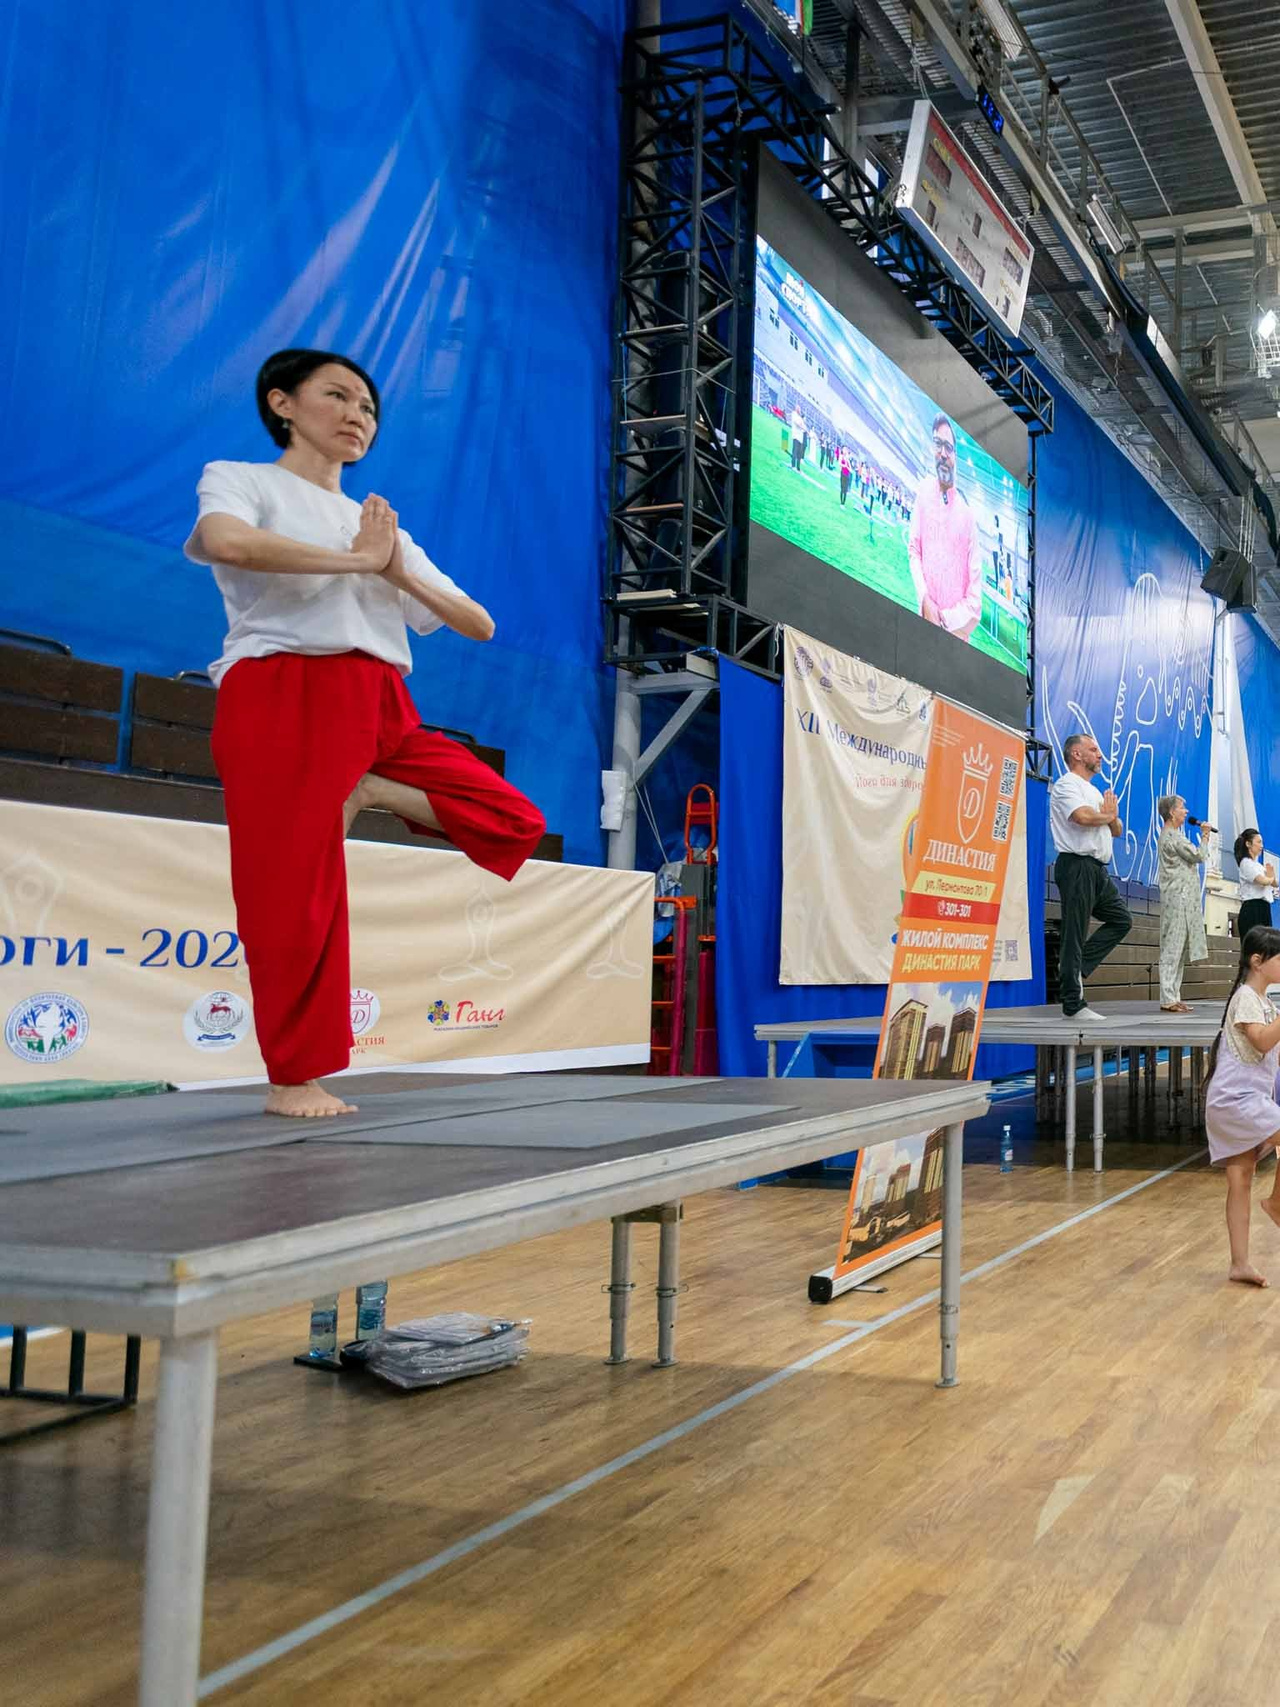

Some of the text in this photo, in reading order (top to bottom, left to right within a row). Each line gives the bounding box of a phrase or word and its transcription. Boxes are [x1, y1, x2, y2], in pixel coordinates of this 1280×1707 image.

[922, 838, 998, 872] ДИНАСТИЯ
[945, 902, 972, 917] 301-301
[139, 928, 246, 969] 202
[901, 927, 989, 950] ЖИЛОЙ КОМПЛЕКС
[901, 952, 982, 973] ДИНАСТИЯ ПАРК
[354, 1036, 385, 1046] СТИЯ
